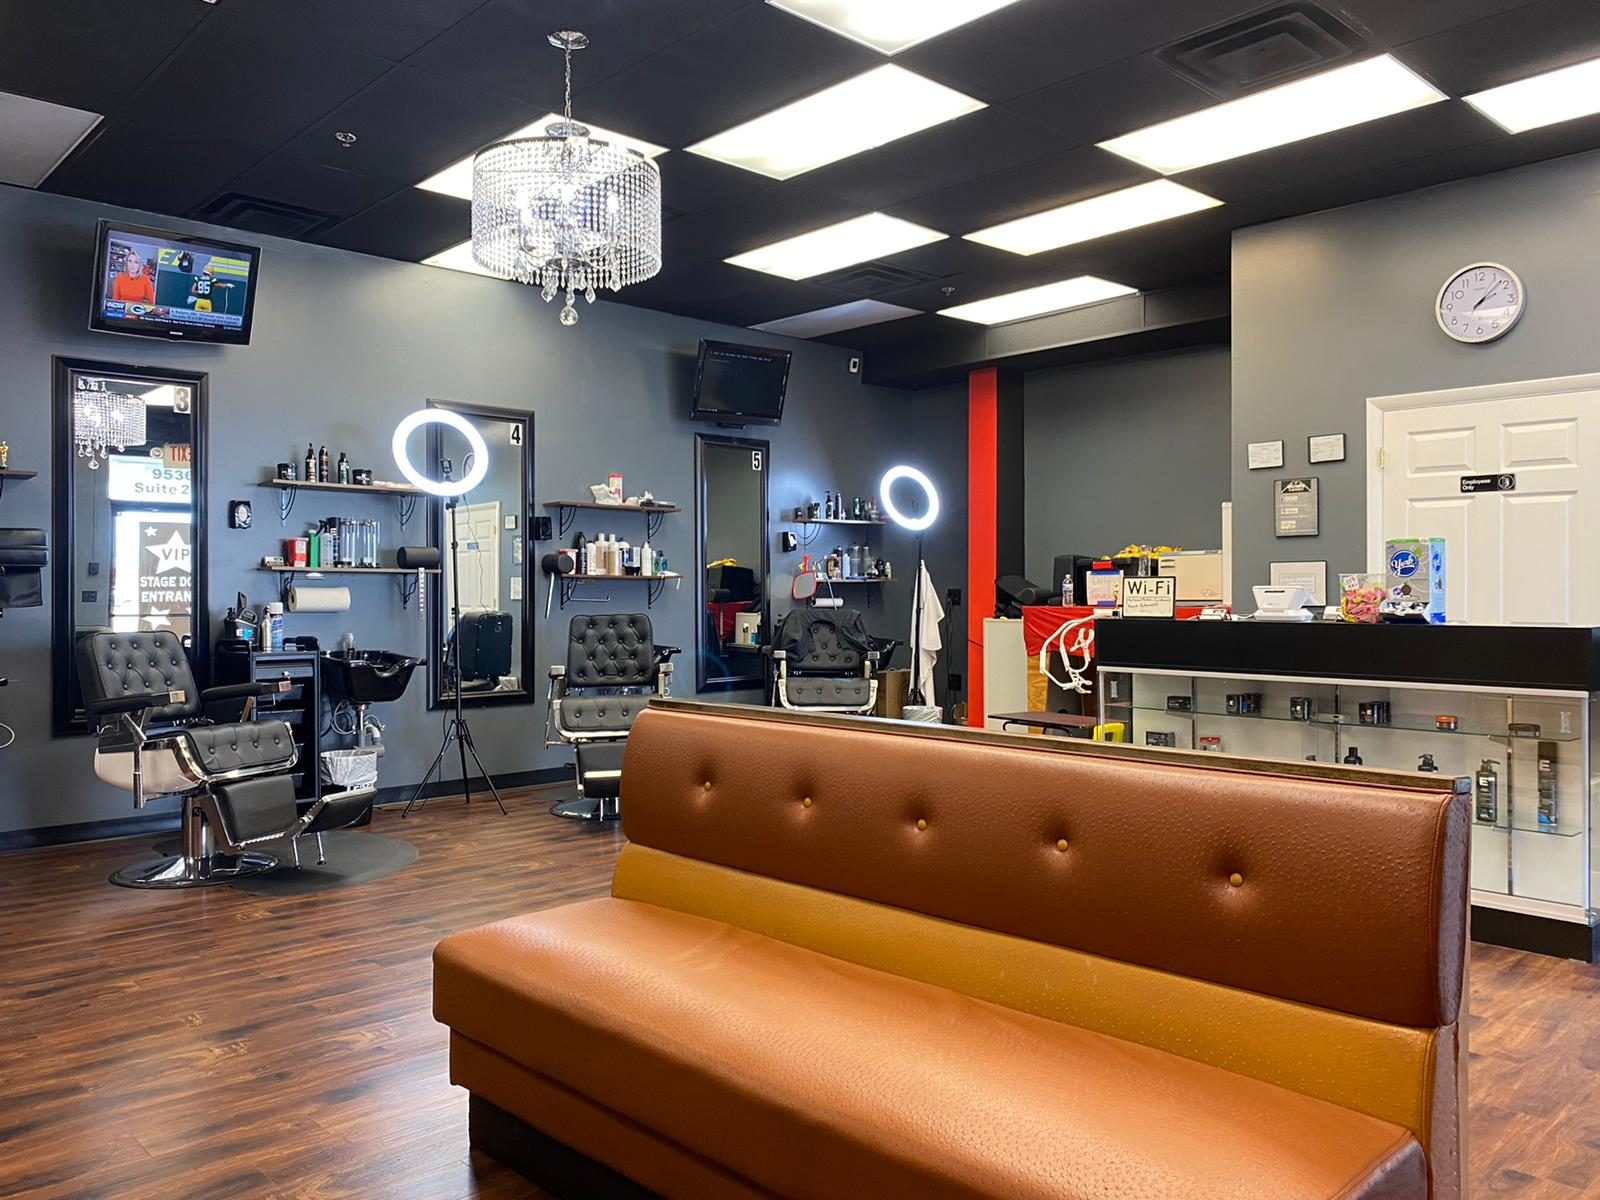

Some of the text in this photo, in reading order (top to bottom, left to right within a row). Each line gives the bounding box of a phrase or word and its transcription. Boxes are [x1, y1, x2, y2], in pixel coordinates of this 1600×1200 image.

[1475, 272, 1485, 281] 12
[1462, 279, 1469, 288] 11
[1503, 280, 1509, 290] 2
[1451, 290, 1464, 300] 10
[1507, 294, 1515, 303] 3
[1446, 303, 1453, 312] 9
[1451, 316, 1457, 325] 8
[1491, 320, 1499, 329] 5
[1463, 323, 1469, 332] 7
[1476, 327, 1483, 335] 6
[175, 387, 189, 412] 3
[511, 424, 521, 444] 4
[170, 445, 191, 462] TIX
[753, 452, 761, 469] 5
[134, 482, 190, 495] Suite 2
[162, 548, 190, 561] VIP
[1390, 554, 1415, 577] York
[140, 576, 176, 588] STAGE
[1128, 581, 1171, 595] Wi-Fi
